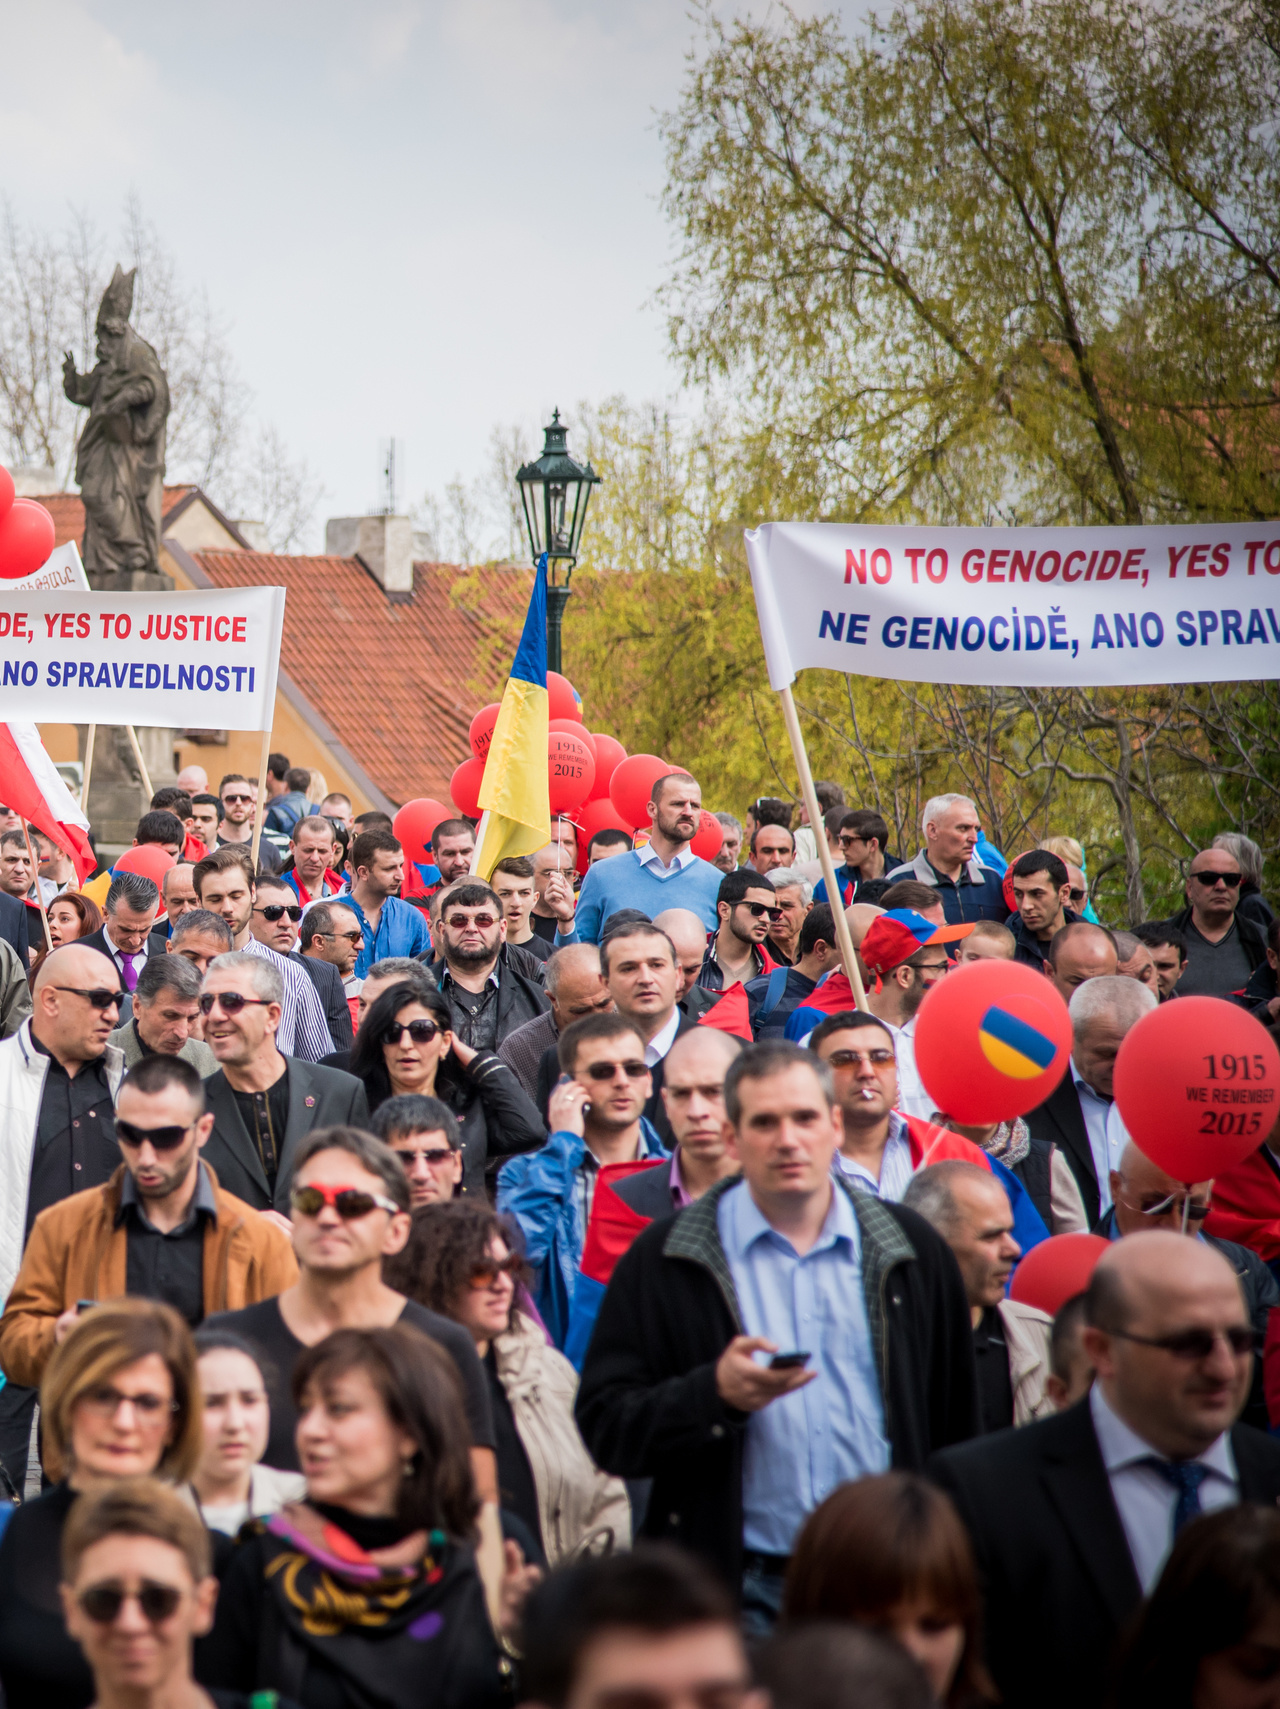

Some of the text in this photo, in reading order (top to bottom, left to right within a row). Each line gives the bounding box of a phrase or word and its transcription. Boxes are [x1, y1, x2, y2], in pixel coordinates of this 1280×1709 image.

[843, 540, 1280, 588] NO TO GENOCIDE, YES TO
[44, 612, 91, 639] YES
[99, 613, 132, 639] TO
[139, 614, 247, 643] JUSTICE
[818, 610, 871, 645] NE
[1091, 611, 1164, 649] ANO
[46, 661, 255, 693] SPRAVEDLNOSTI
[556, 742, 584, 754] 1915
[558, 754, 588, 766] REMEMBER
[554, 764, 583, 778] 2015
[1203, 1054, 1266, 1080] 1915
[1186, 1086, 1275, 1104] WE REMEMBER
[1198, 1110, 1263, 1136] 2015
